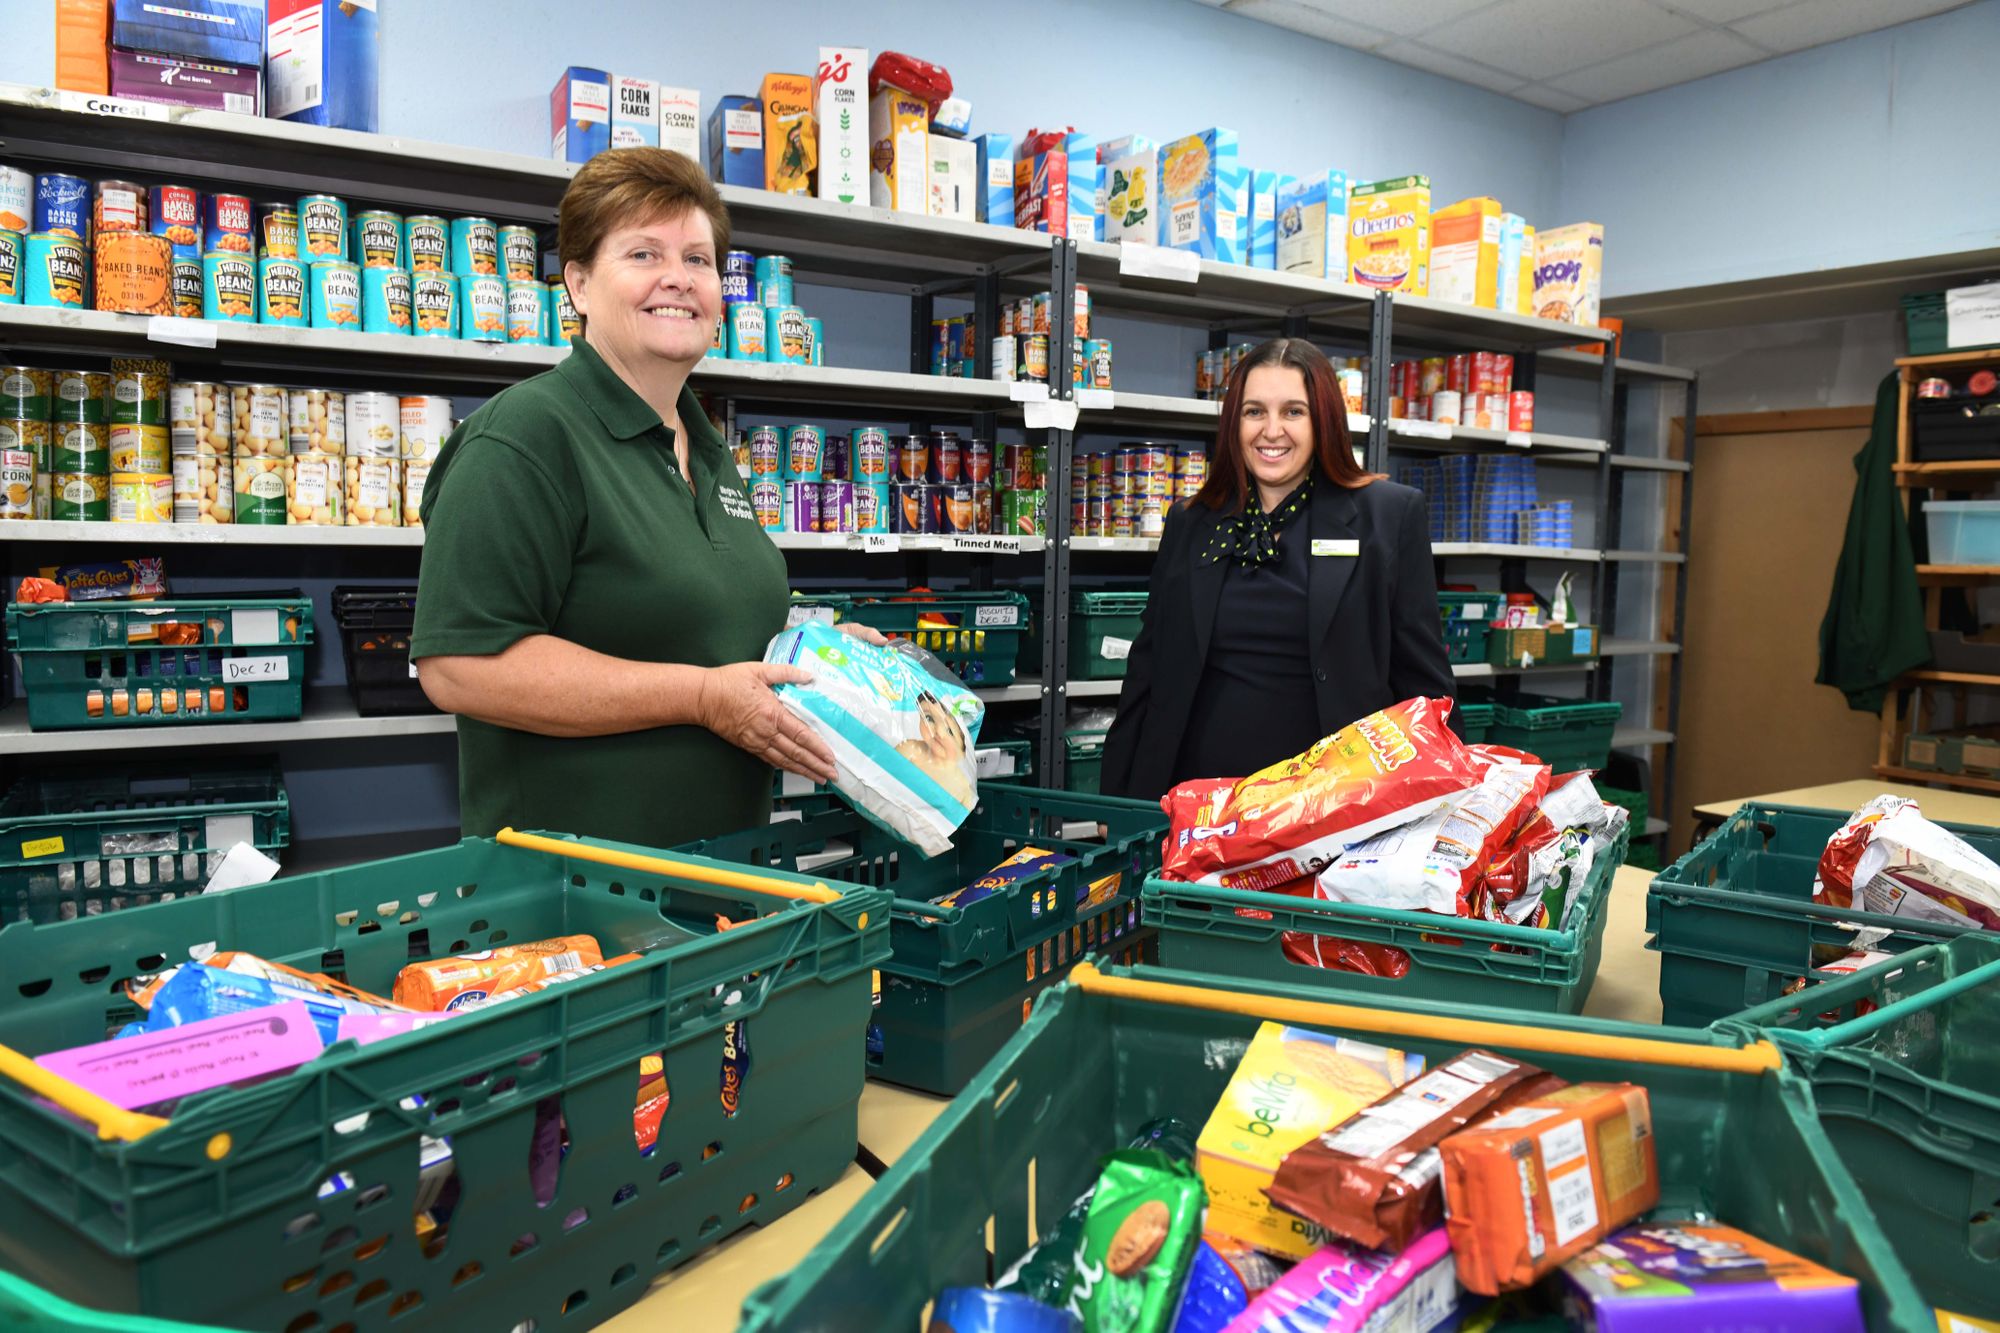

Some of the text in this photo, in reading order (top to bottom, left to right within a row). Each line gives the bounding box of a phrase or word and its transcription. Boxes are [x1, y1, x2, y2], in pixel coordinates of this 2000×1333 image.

[621, 88, 650, 105] CORN
[834, 88, 856, 97] CORN
[86, 99, 147, 118] Cereal
[621, 104, 650, 118] FLAKES
[665, 112, 696, 123] CORN
[665, 120, 696, 130] FLAKES
[163, 199, 196, 213] BAKED
[308, 204, 338, 218] HEINZ
[47, 208, 78, 219] BAKED
[163, 210, 196, 223] BEANS
[218, 208, 250, 222] BAKED
[47, 215, 78, 227] BEANS
[218, 217, 249, 231] BEANS
[305, 216, 341, 233] BEANZ
[367, 220, 396, 235] HEINZ
[1352, 212, 1416, 238] Cheerios
[269, 226, 299, 239] BAKE
[414, 226, 442, 240] HEINZ
[364, 233, 398, 250] BEANZ
[411, 237, 445, 253] BEANZ
[507, 235, 535, 251] HEINZ
[506, 248, 536, 265] BEANZ
[103, 262, 166, 278] BAKED BEANS
[176, 265, 202, 280] HEINZ
[220, 262, 251, 276] HEINZ
[268, 266, 300, 279] HEINZ
[1533, 260, 1583, 291] HOOPS
[217, 275, 253, 291] BEANZ
[331, 270, 356, 284] HEINZ
[722, 276, 748, 288] AKED
[173, 278, 204, 294] BEANZ
[266, 279, 303, 294] BEANZ
[327, 285, 360, 299] BEANZ
[418, 280, 447, 293] HEINZ
[477, 280, 502, 294] HEINZ
[722, 286, 748, 297] EANS
[415, 292, 451, 307] BEANZ
[474, 295, 504, 307] BEANZ
[509, 290, 534, 302] HEINZ
[507, 303, 538, 315] BEANZ
[741, 308, 763, 319] HEINZ
[738, 320, 765, 332] BEANZ
[754, 432, 777, 445] HEINZ
[794, 431, 817, 444] HEINZ
[862, 435, 883, 447] HEINZ
[751, 444, 779, 458] BEANZ
[791, 443, 818, 456] BEANZ
[859, 446, 887, 459] BEANZ
[2, 470, 32, 483] CORN
[755, 484, 778, 497] HEINZ
[752, 495, 781, 509] BEANZ
[953, 537, 1020, 554] Tinned Meat
[95, 566, 129, 588] Cakes
[229, 661, 277, 679] Dec 21
[720, 1020, 739, 1113] Cakes BAR
[1233, 1071, 1297, 1138] belVita
